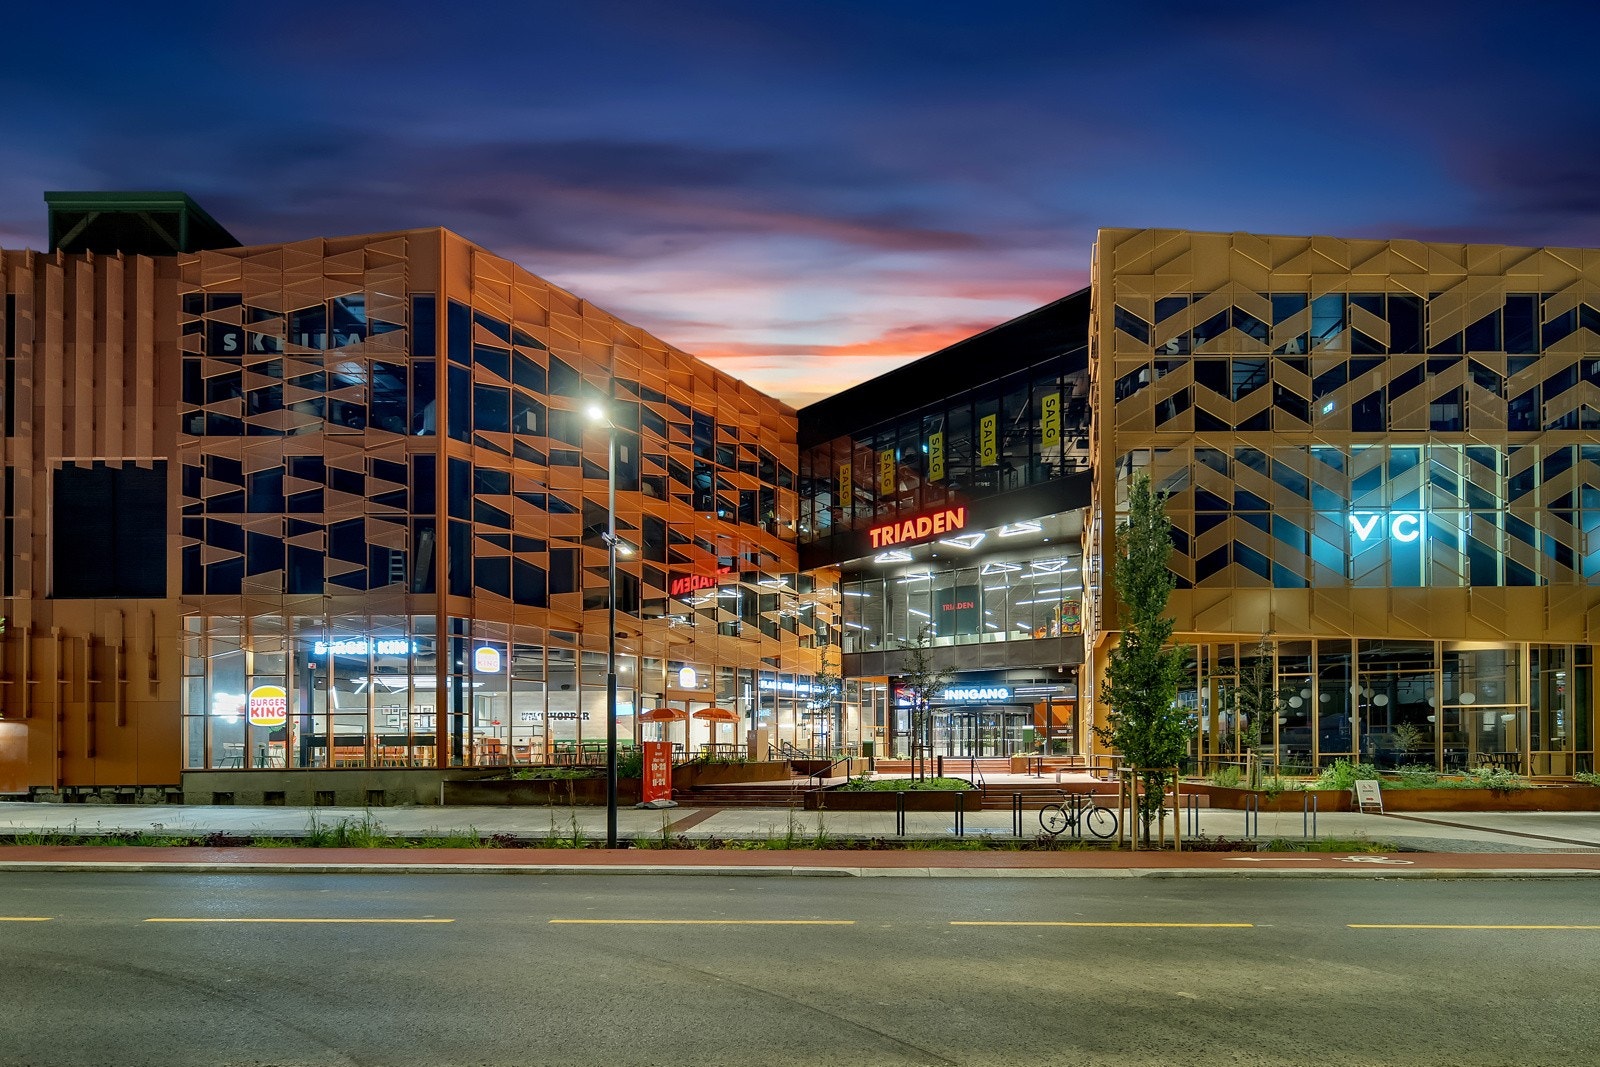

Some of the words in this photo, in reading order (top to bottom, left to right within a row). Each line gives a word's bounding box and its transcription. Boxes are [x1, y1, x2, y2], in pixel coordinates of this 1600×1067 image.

[223, 333, 391, 351] SKIDA
[1046, 399, 1056, 439] SALG
[983, 420, 993, 457] SALG
[932, 437, 940, 473] SALG
[870, 507, 964, 549] TRIADEN
[250, 698, 286, 707] BURGER
[945, 688, 1009, 700] INNGANG
[250, 707, 287, 718] KING
[537, 711, 590, 721] HOPPR
